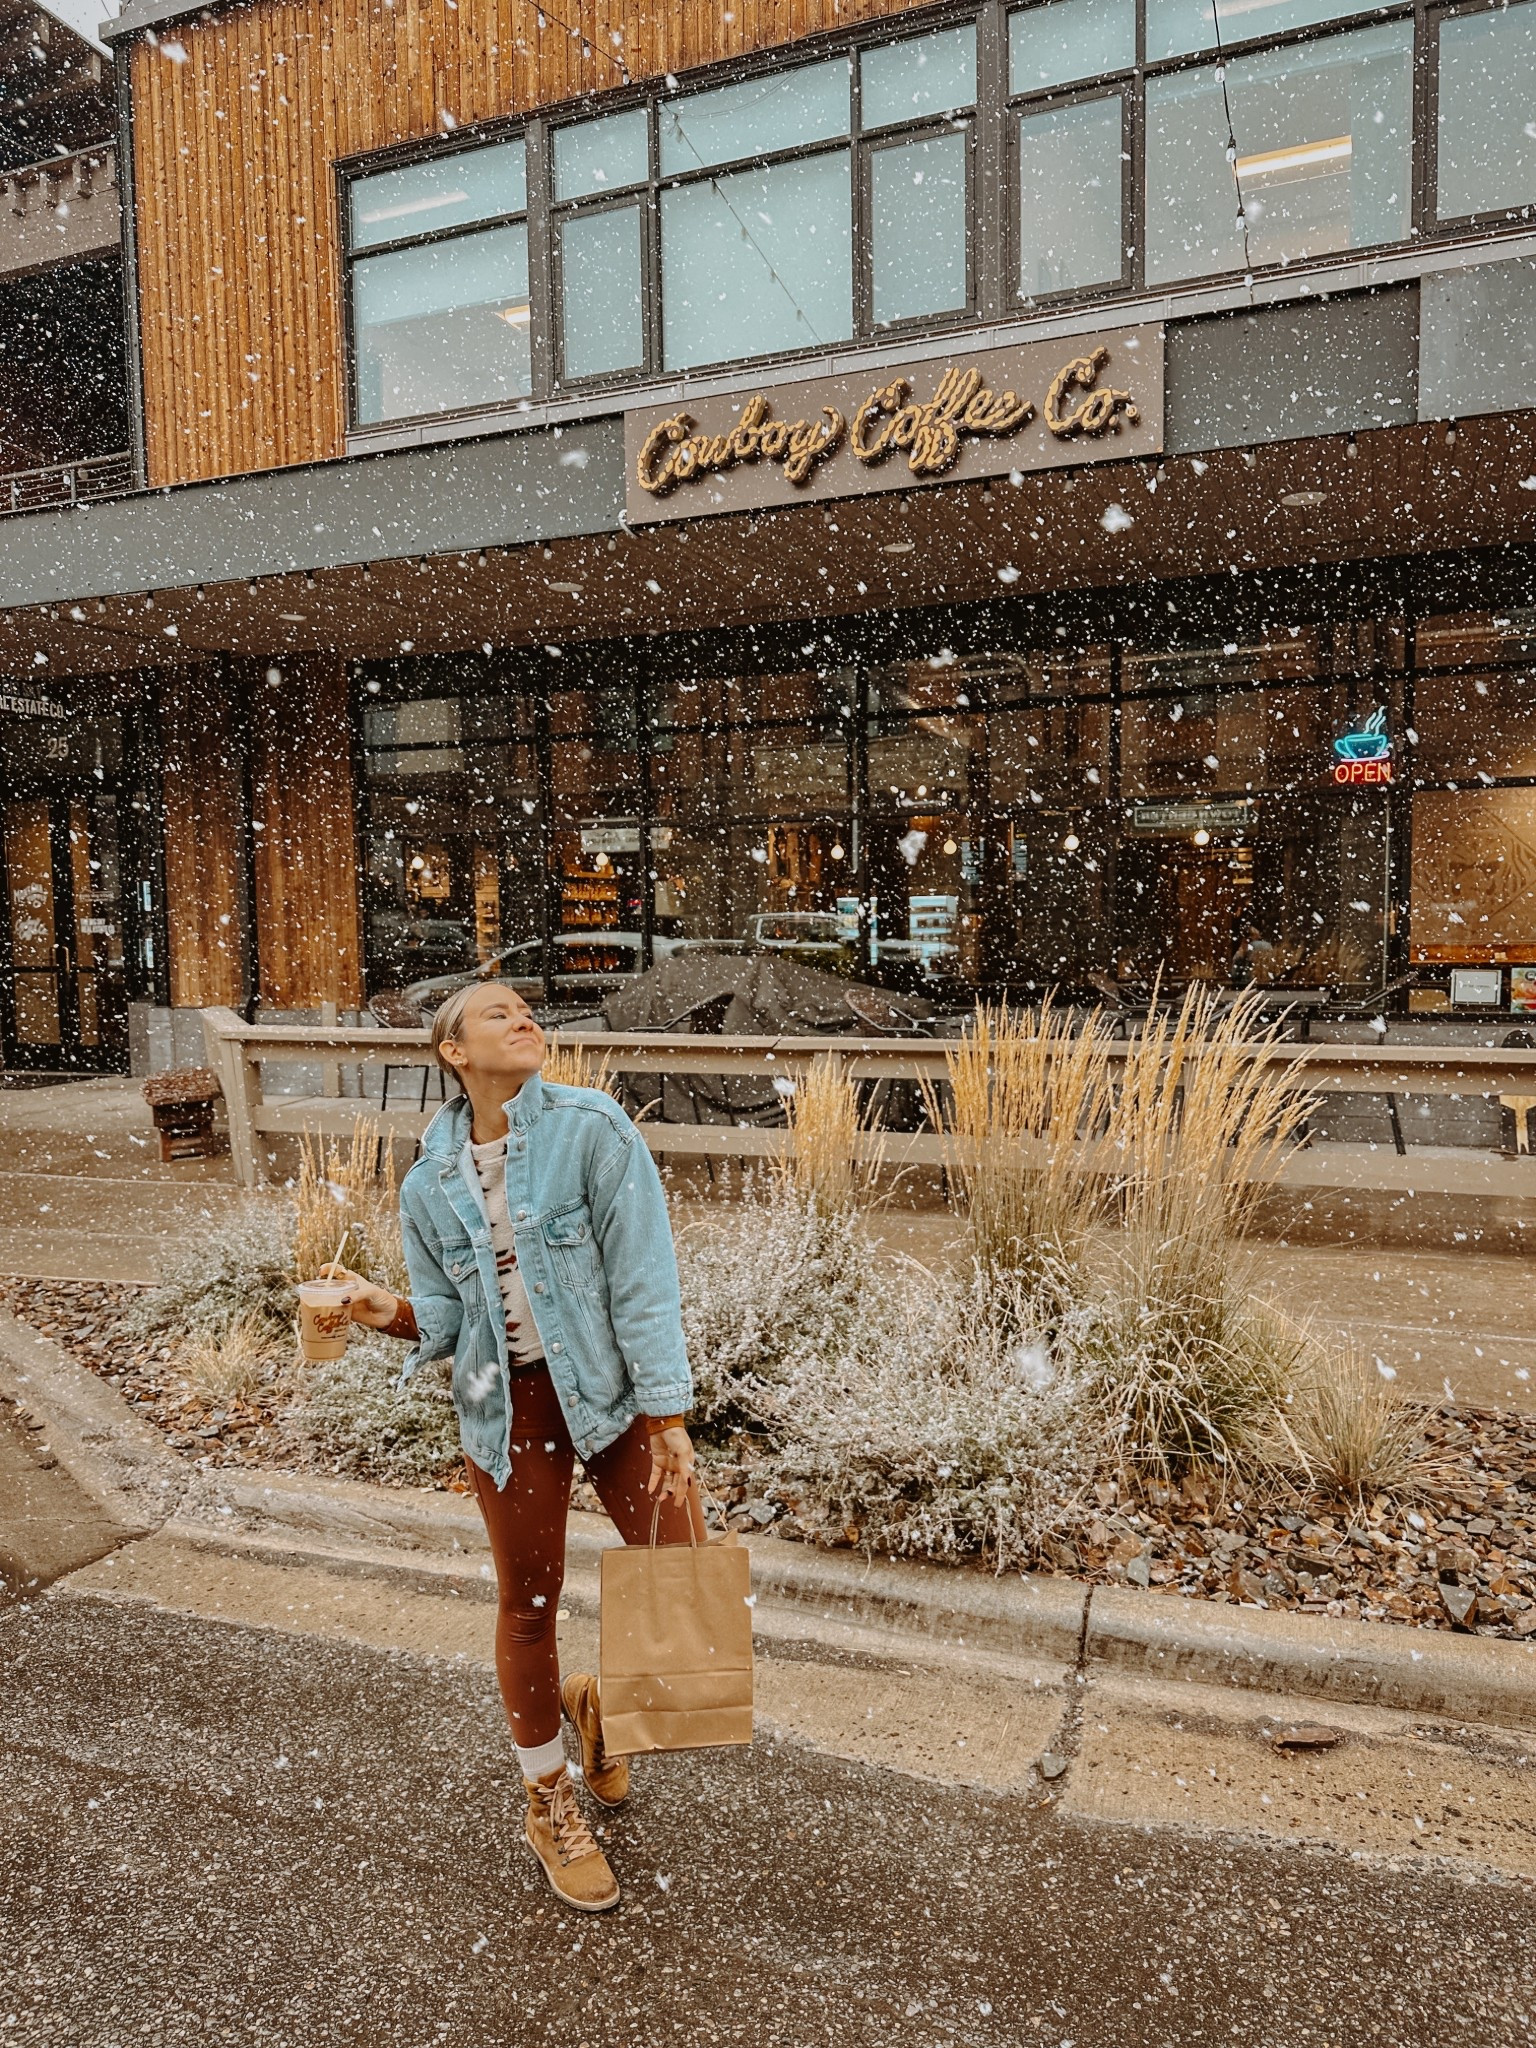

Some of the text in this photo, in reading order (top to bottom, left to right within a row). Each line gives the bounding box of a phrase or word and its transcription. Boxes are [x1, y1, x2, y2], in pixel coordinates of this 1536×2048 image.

[636, 393, 846, 492] Cowboy
[850, 366, 1032, 472] Coffee
[11, 697, 50, 716] ESTATE
[48, 736, 69, 758] 25
[1334, 762, 1391, 784] OPEN
